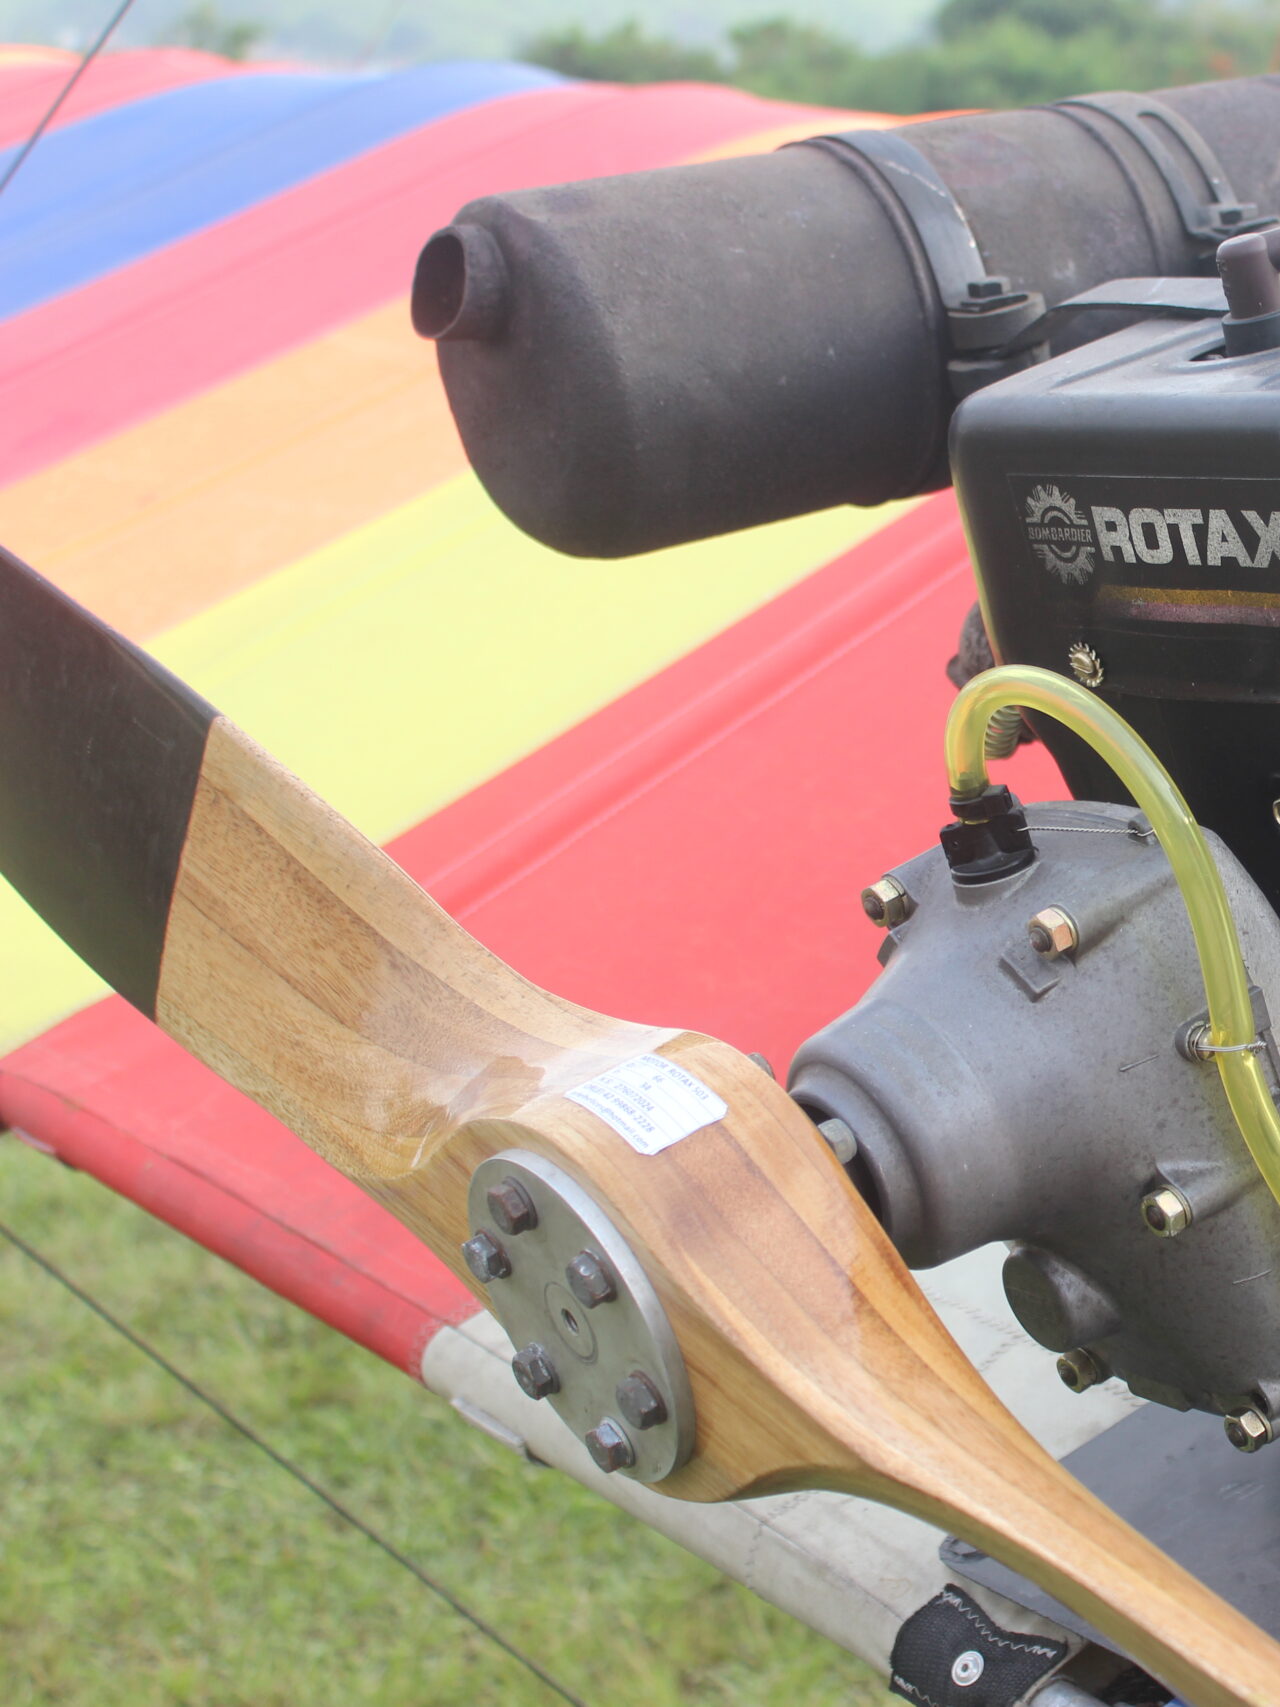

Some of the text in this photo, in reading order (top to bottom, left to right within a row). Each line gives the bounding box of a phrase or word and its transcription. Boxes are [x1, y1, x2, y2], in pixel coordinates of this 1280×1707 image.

[1028, 526, 1093, 544] BOMBARDIER
[640, 1055, 710, 1101] MOTOR ROTAX 503
